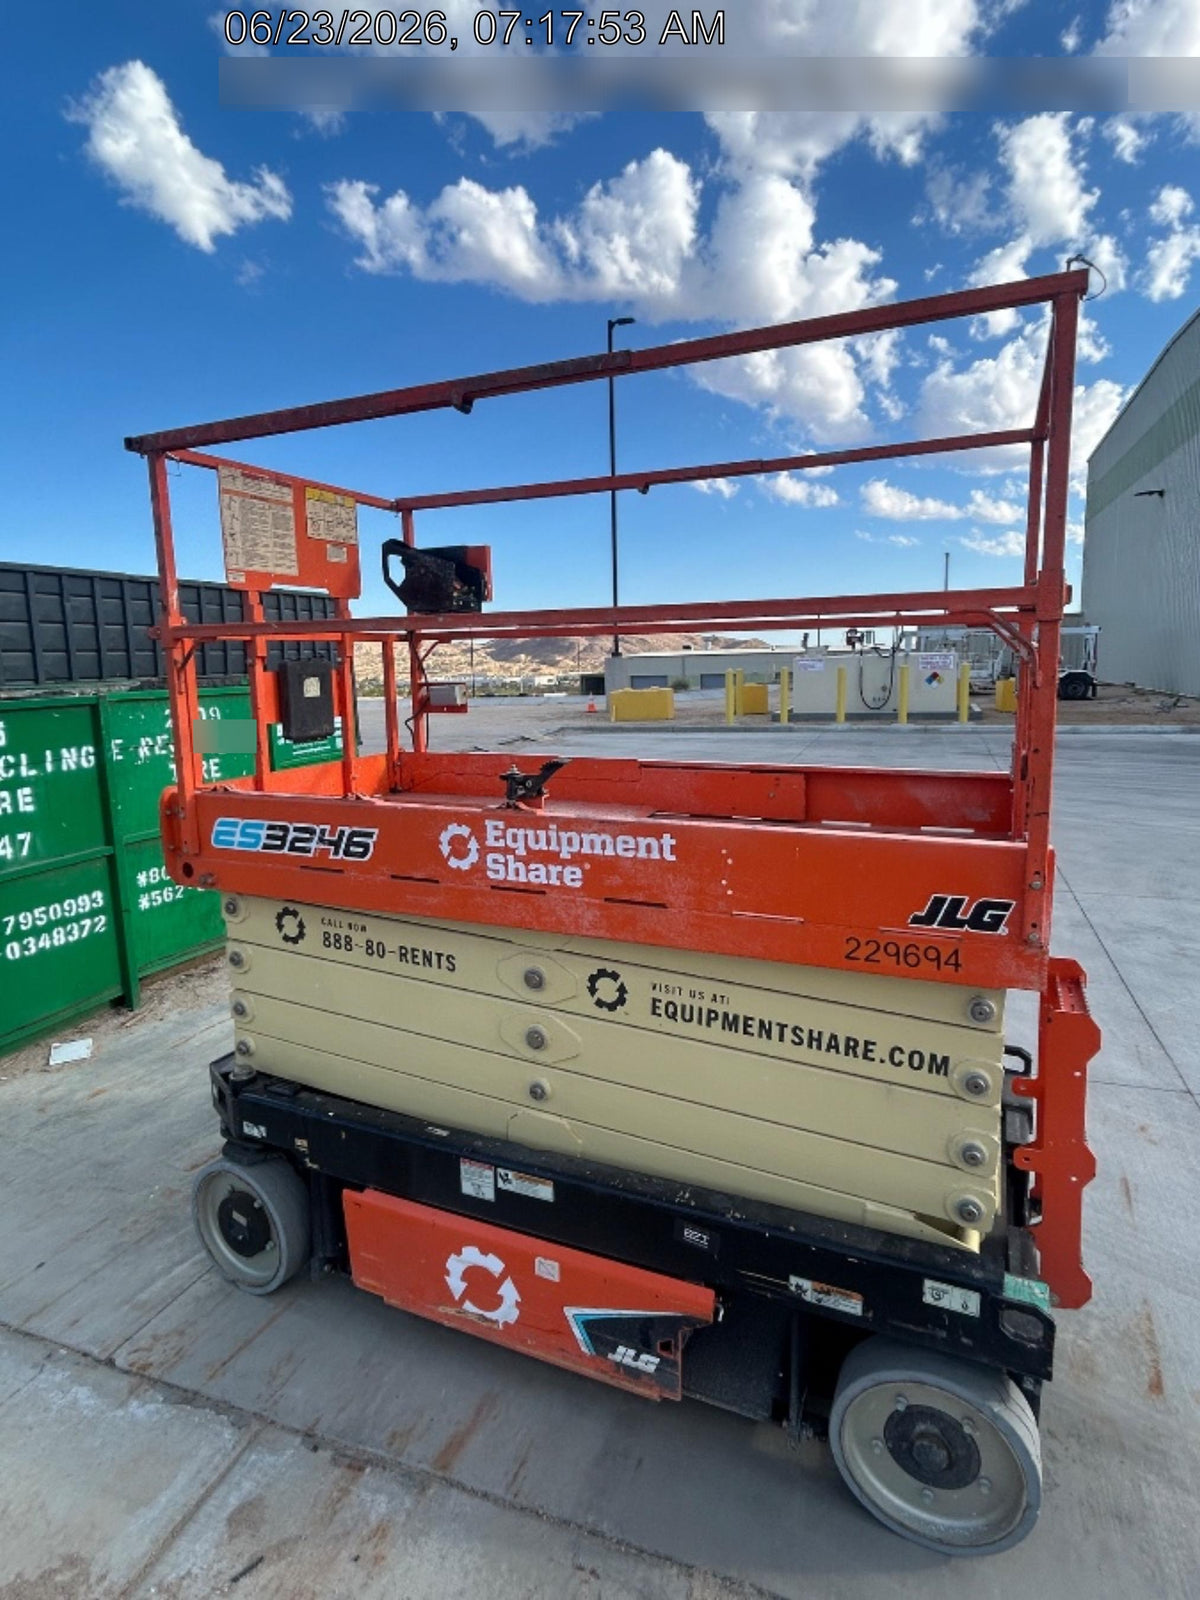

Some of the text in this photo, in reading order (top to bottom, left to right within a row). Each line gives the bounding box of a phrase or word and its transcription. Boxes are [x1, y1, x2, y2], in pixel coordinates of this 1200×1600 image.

[211, 817, 379, 861] ES3246
[485, 819, 677, 861] Equipment
[486, 853, 583, 888] Share
[2, 890, 104, 936] 7950993
[321, 917, 344, 929] CALL
[908, 894, 1016, 935] JLG
[6, 915, 107, 960] 0348372
[322, 931, 456, 972] 888-80-RENTS
[845, 936, 962, 973] 229694
[651, 982, 683, 997] VISIT
[689, 989, 705, 1000] US
[651, 997, 951, 1077] EQUIPMENTSHARE.COM
[607, 1345, 661, 1373] JLG
